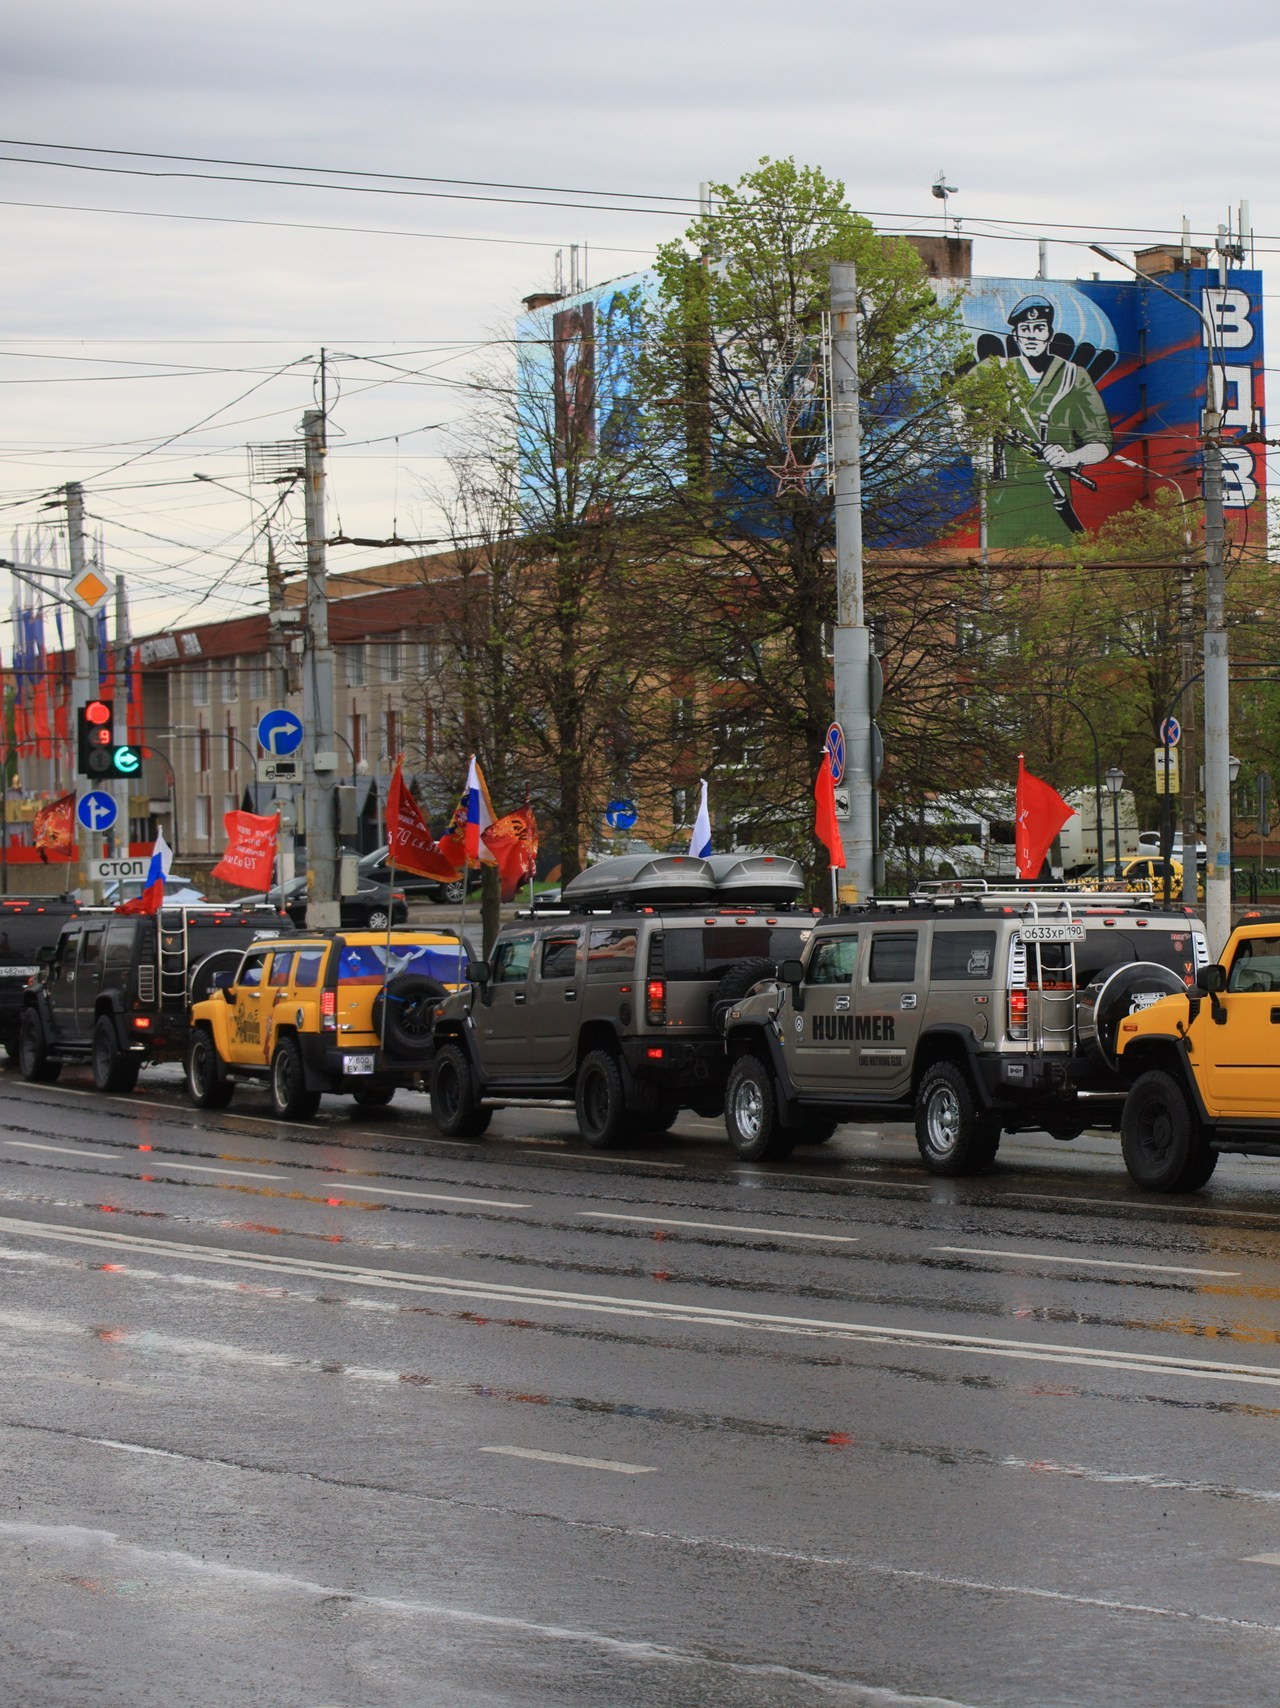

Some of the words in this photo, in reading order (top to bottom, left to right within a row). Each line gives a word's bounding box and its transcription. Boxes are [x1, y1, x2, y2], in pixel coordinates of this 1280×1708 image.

[1201, 288, 1265, 509] ВДВ
[99, 861, 143, 877] СТОП
[1024, 927, 1064, 939] О633ХР
[1066, 926, 1081, 936] 190
[812, 1015, 895, 1040] HUMMER
